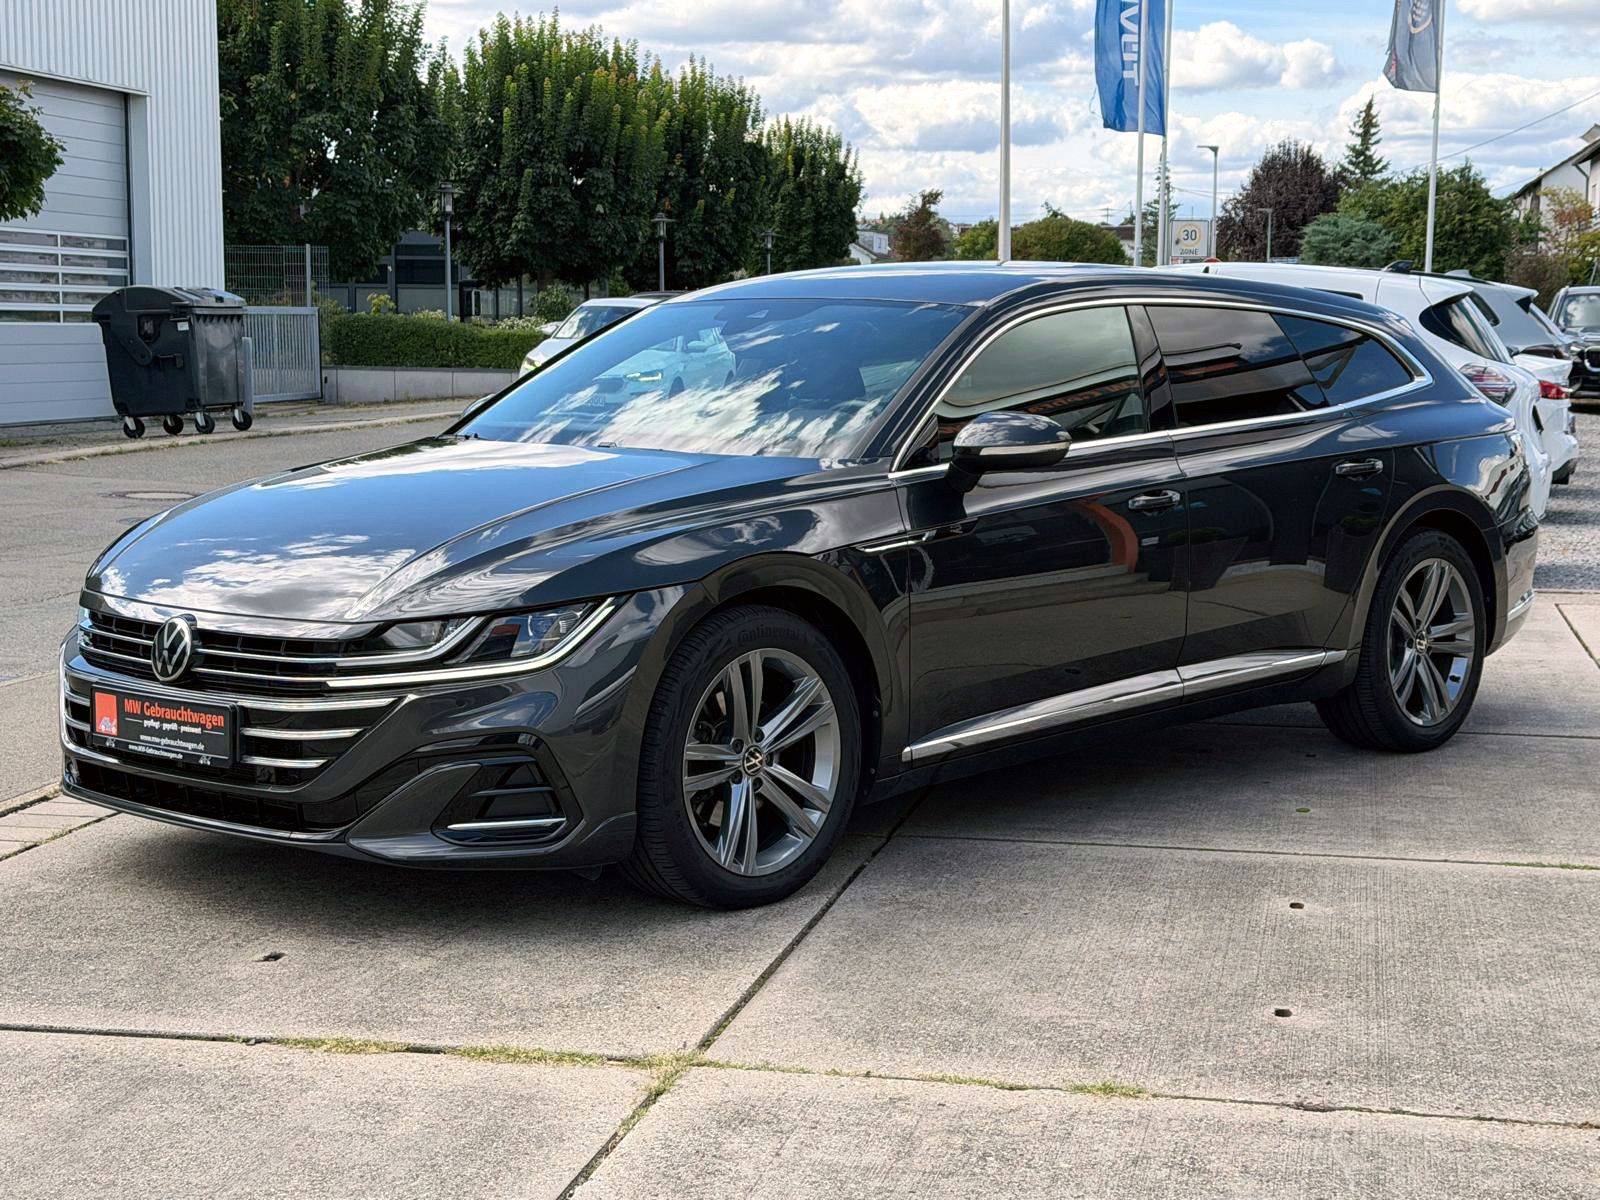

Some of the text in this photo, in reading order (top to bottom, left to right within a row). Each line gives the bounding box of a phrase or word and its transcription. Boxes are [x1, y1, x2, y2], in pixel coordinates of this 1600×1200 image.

[1182, 229, 1197, 241] 30
[1180, 248, 1199, 256] ZONE
[124, 698, 225, 730] MW Gebrauchtwagen
